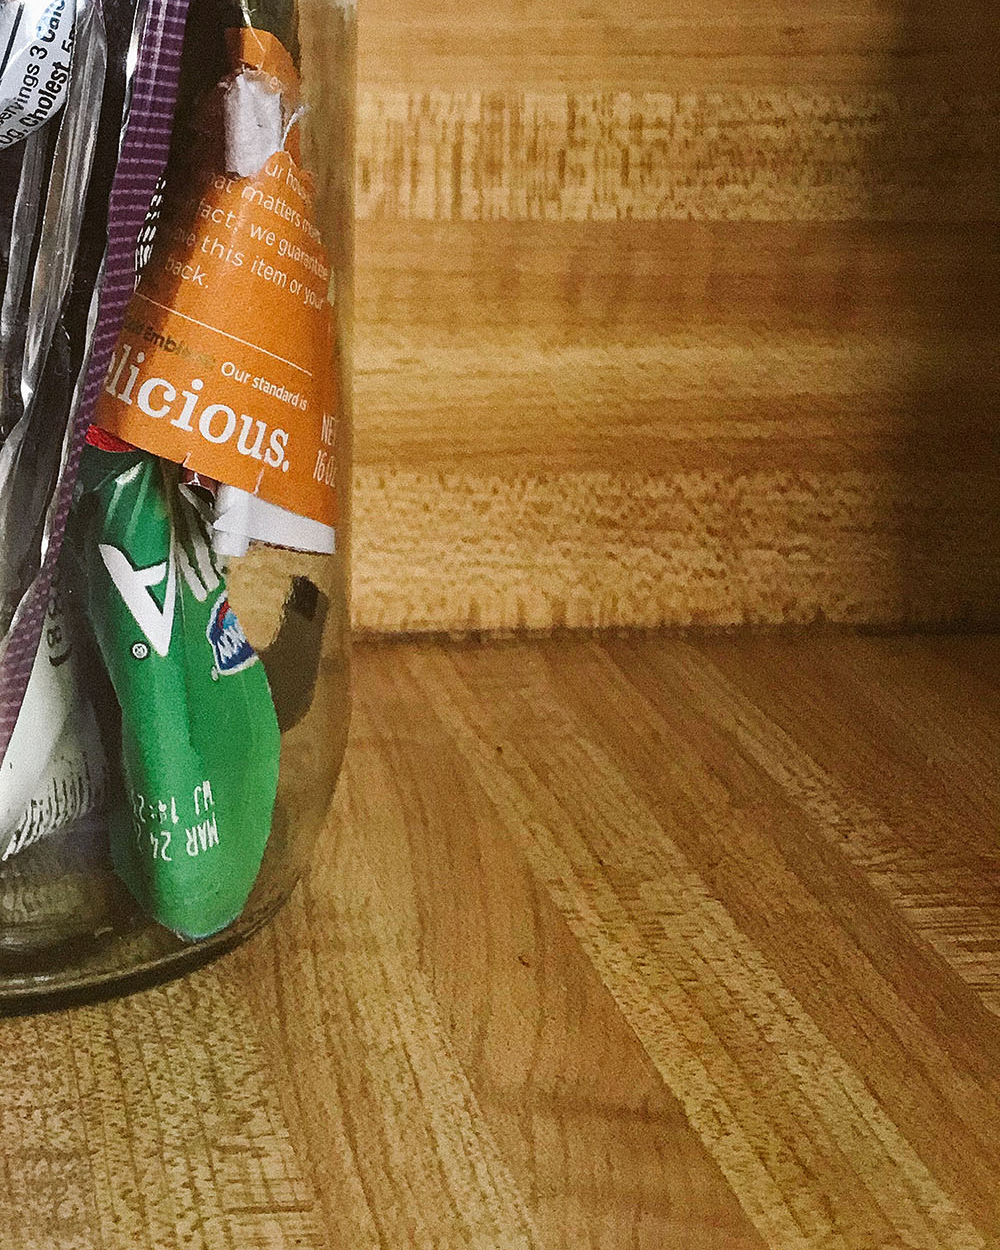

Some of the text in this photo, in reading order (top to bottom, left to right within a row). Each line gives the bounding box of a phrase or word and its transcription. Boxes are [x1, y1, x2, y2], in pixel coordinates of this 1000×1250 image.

[29, 45, 48, 60] 3
[241, 185, 302, 229] matters
[250, 222, 276, 247] we
[164, 253, 210, 290] back.
[201, 235, 246, 268] this
[251, 254, 288, 288] item
[289, 278, 304, 296] or
[220, 361, 309, 412] Our standard is
[149, 831, 173, 862] 24
[185, 811, 220, 857] MAR
